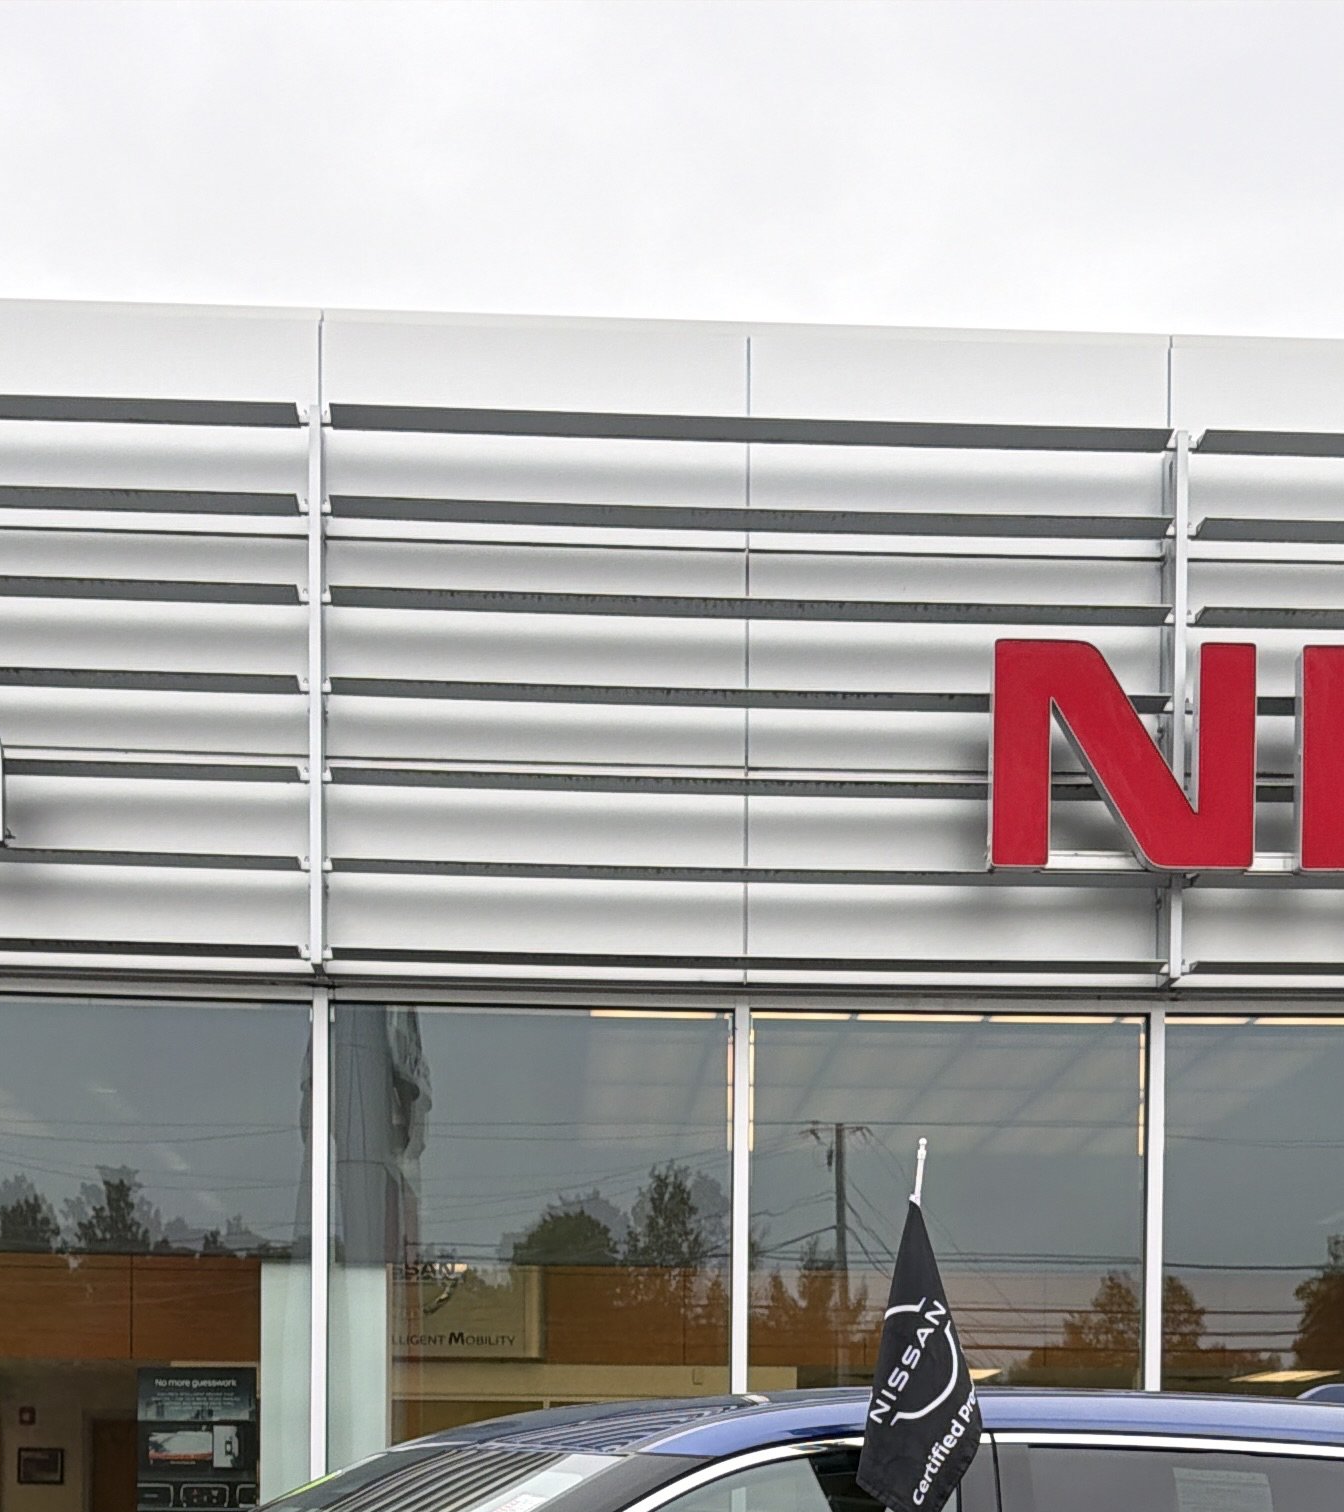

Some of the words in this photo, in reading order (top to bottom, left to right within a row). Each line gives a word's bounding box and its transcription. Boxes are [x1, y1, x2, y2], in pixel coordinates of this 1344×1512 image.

[391, 1334, 446, 1346] LLIGENT
[869, 1300, 947, 1424] NISSAN
[912, 1419, 965, 1506] Certified
